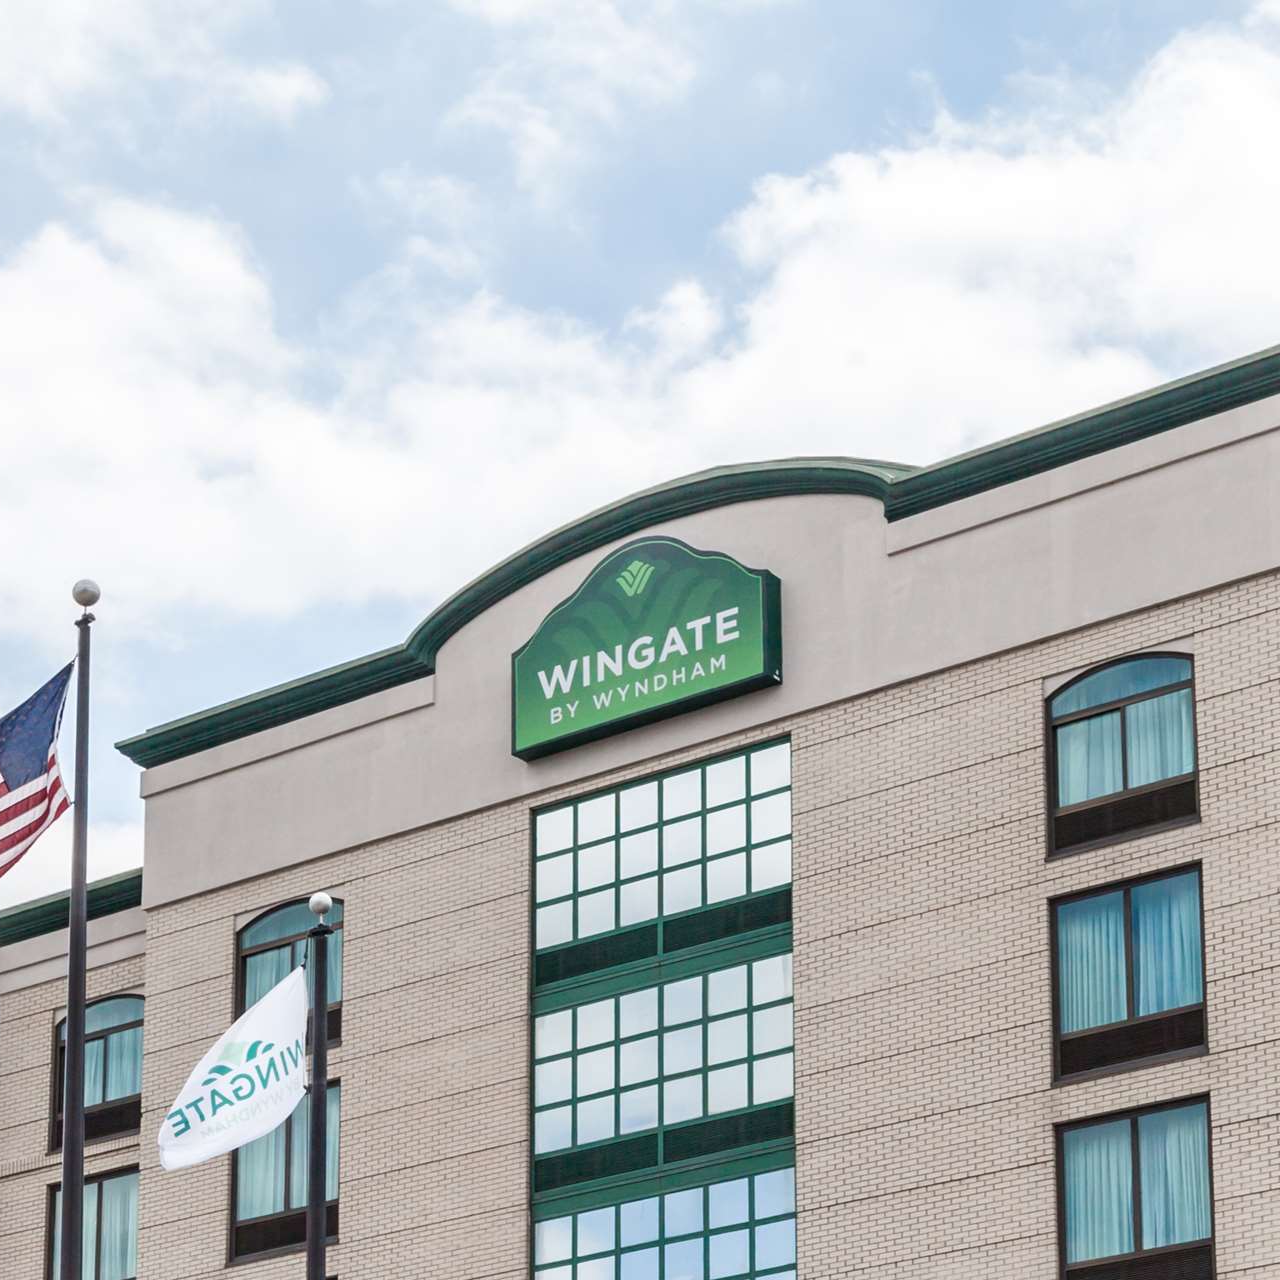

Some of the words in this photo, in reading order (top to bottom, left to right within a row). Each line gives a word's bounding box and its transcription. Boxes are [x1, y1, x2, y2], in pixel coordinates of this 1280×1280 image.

[537, 606, 740, 700] WINGATE
[550, 700, 580, 725] BY
[592, 653, 727, 711] WYNDHAM
